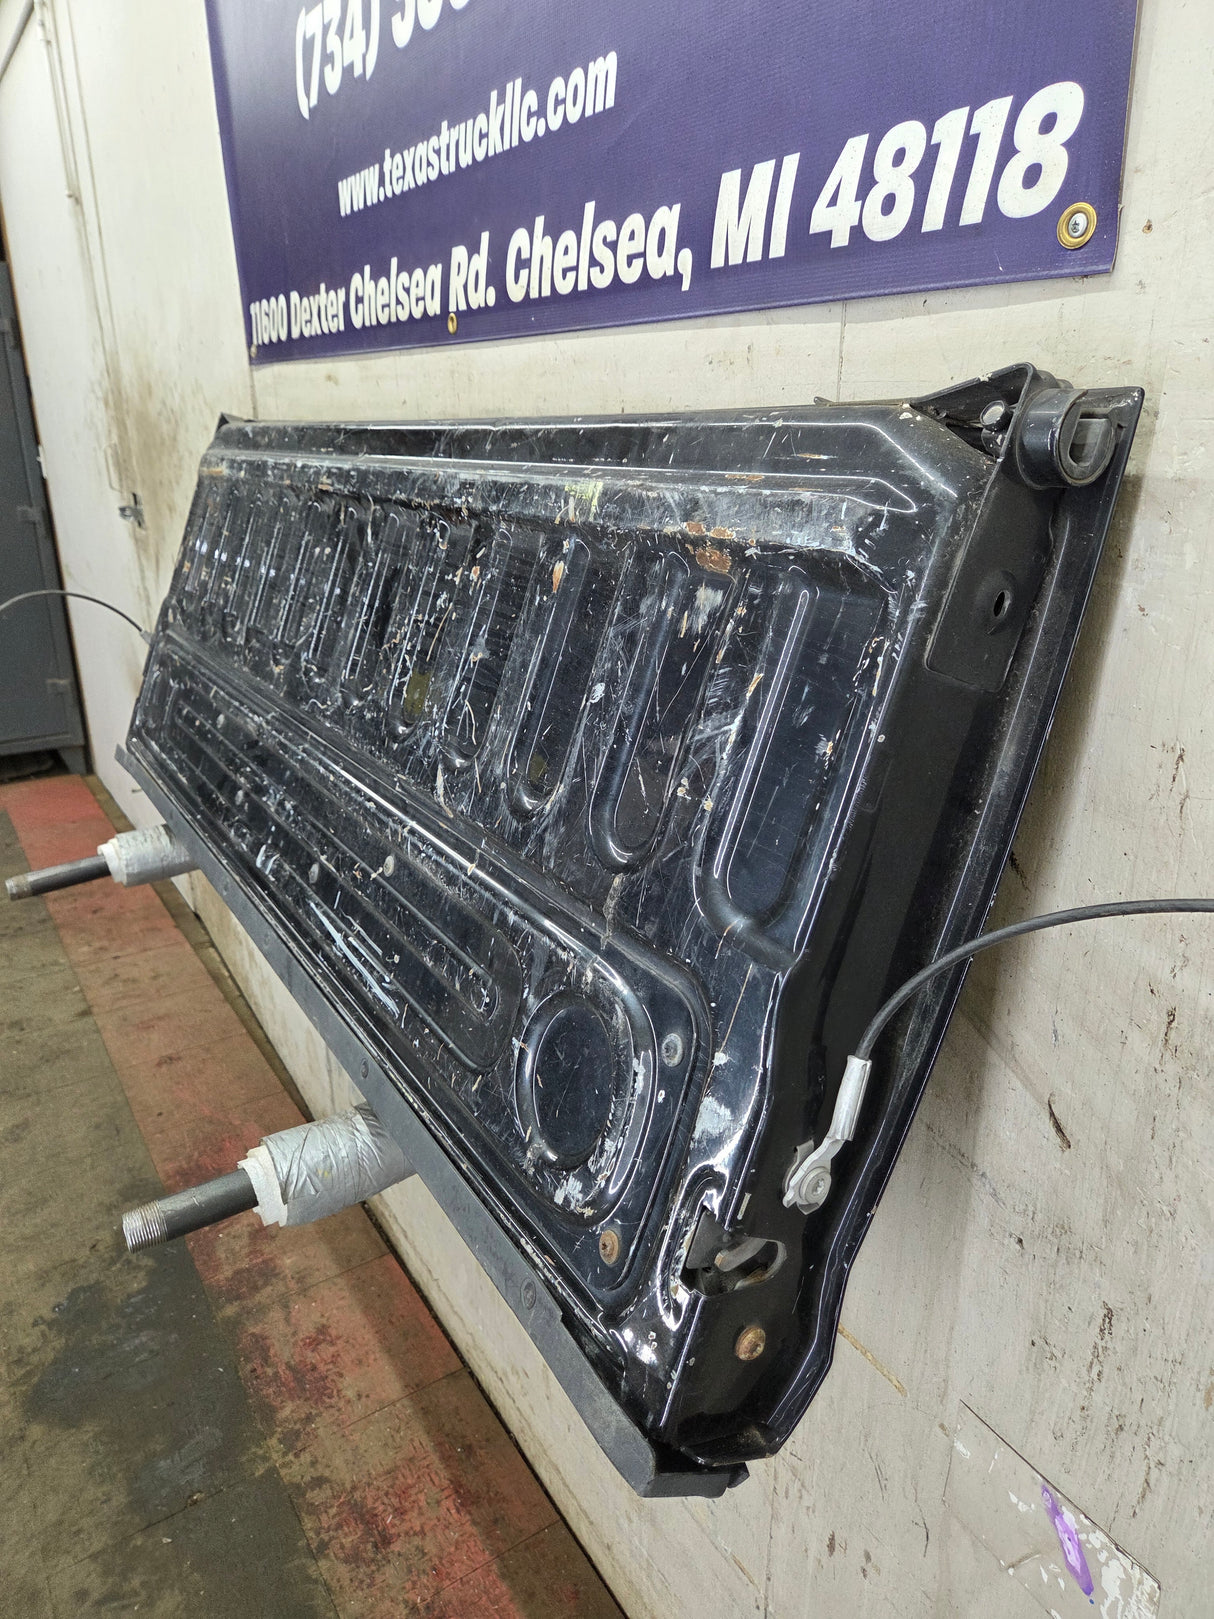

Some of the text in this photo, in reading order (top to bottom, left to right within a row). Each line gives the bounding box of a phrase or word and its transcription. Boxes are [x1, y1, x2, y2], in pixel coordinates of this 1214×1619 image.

[295, 0, 380, 120] (734)
[338, 50, 618, 217] www.texastruckllc.com
[249, 80, 1086, 346] 11600 Dexter Chelsea Rd. Chelsea, MI 48118
